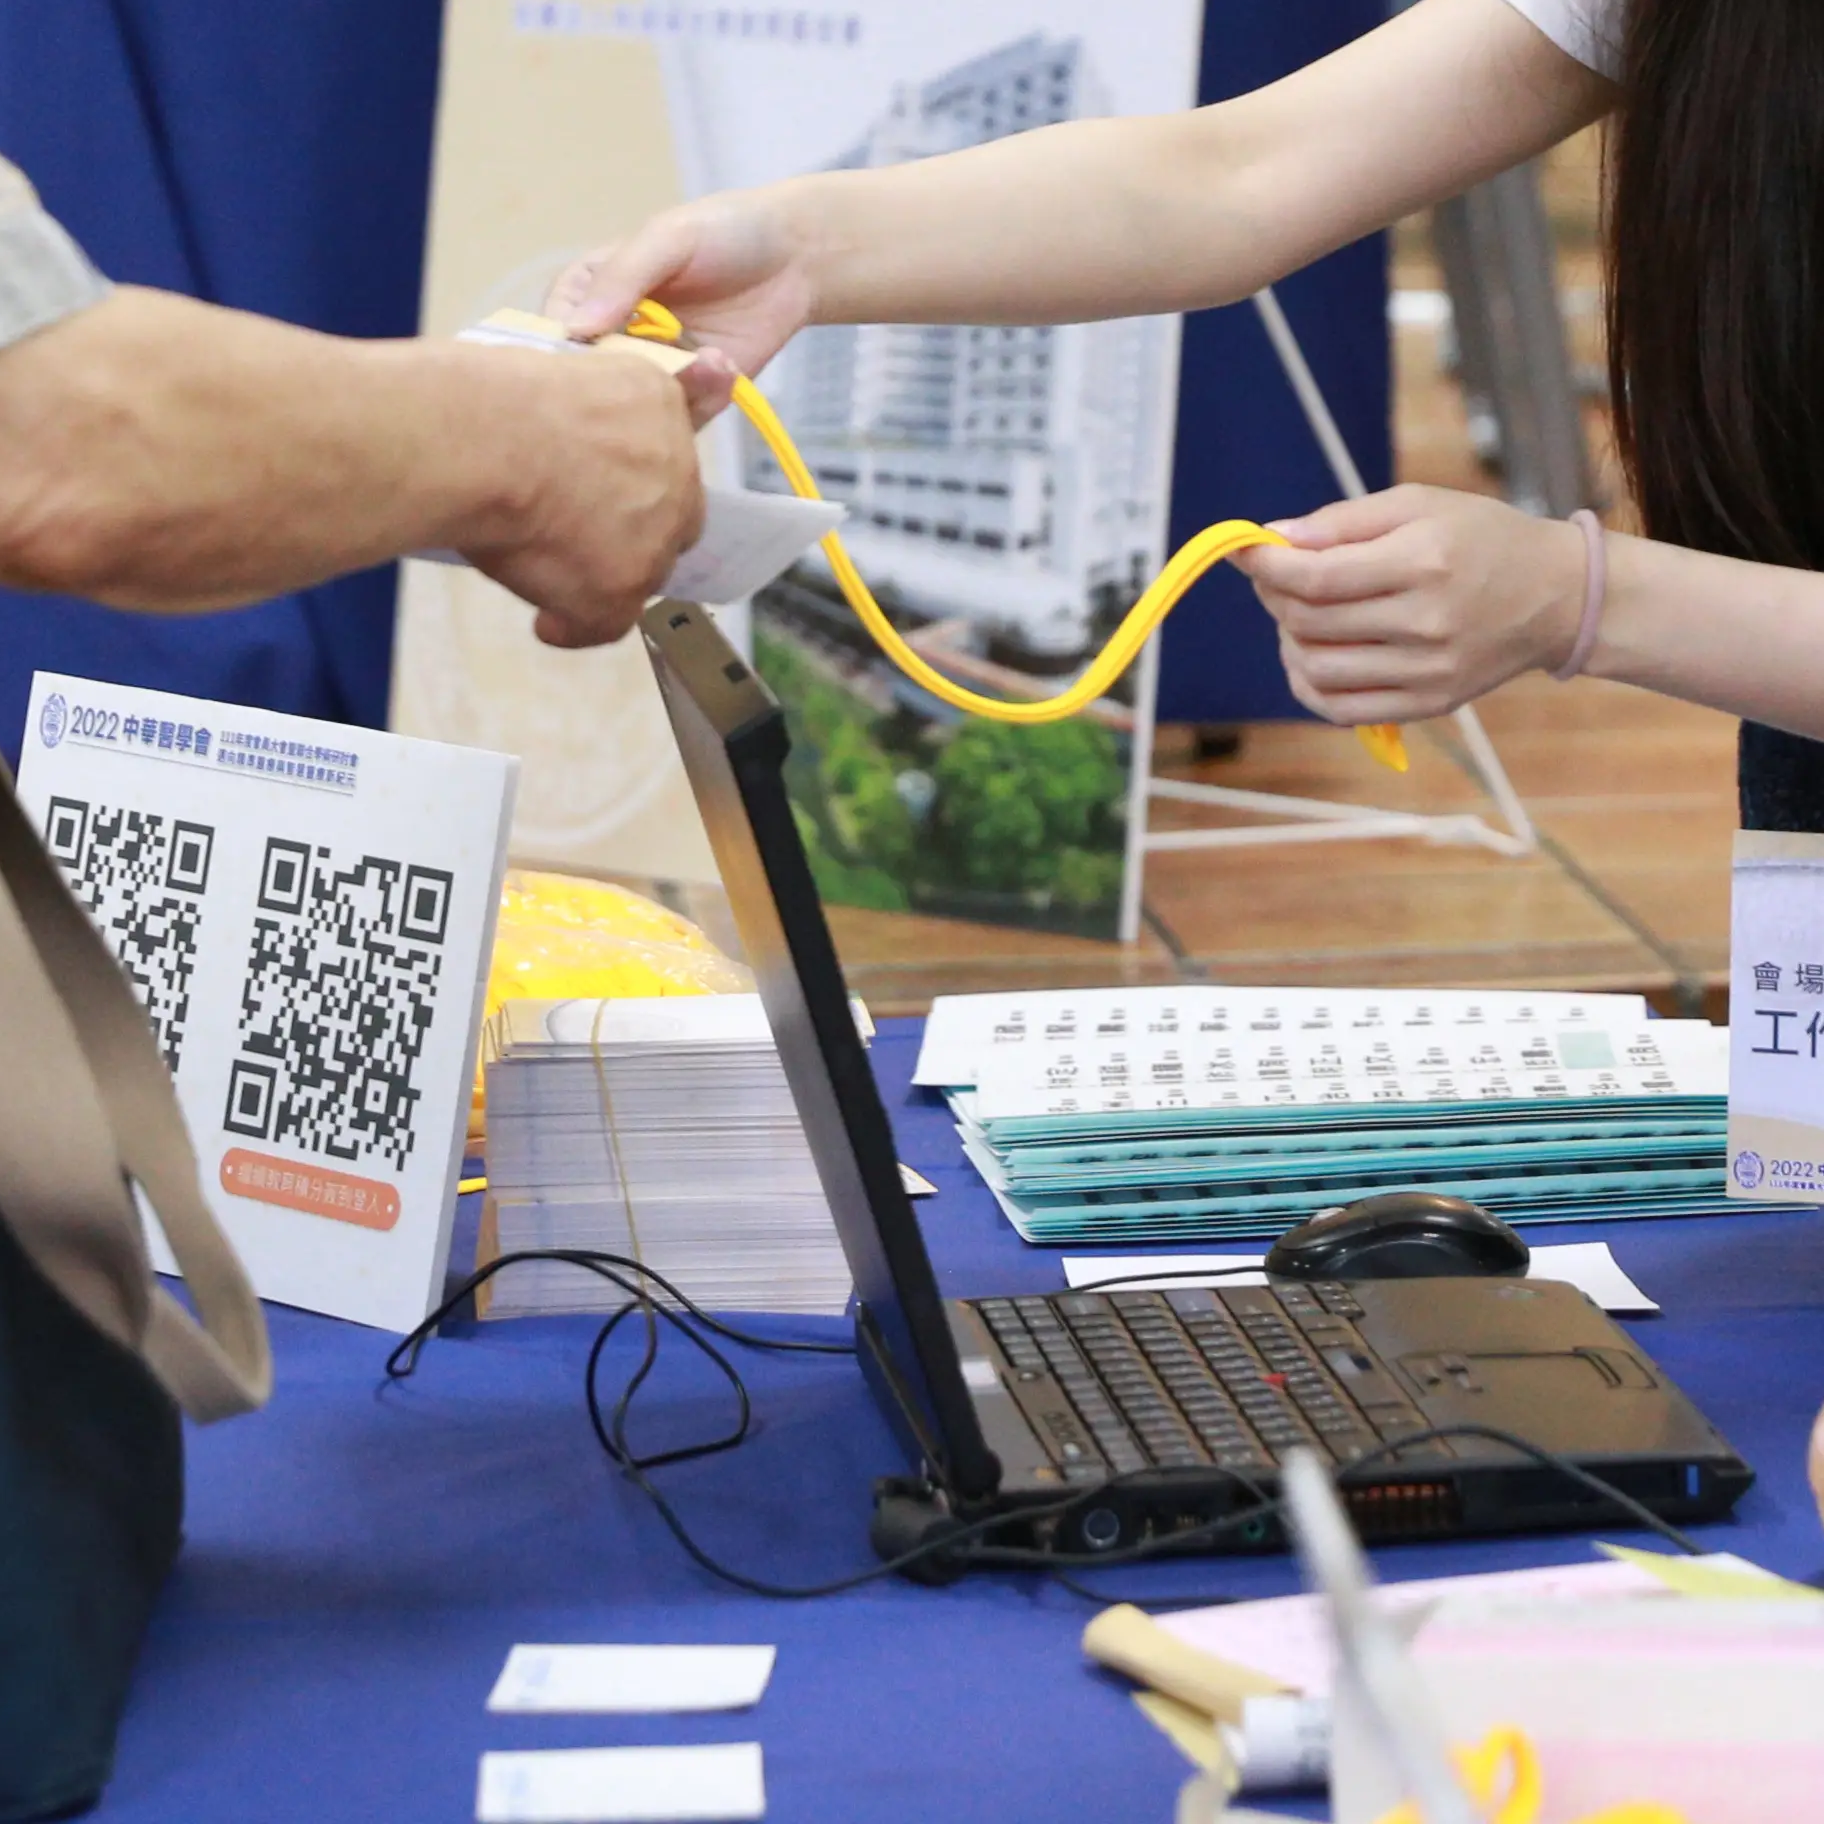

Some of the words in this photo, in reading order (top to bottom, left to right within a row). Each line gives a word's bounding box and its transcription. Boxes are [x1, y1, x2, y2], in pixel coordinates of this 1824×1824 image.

[70, 705, 120, 742] 2022
[123, 714, 213, 757] 中華醫學會
[1769, 1159, 1815, 1178] 2022
